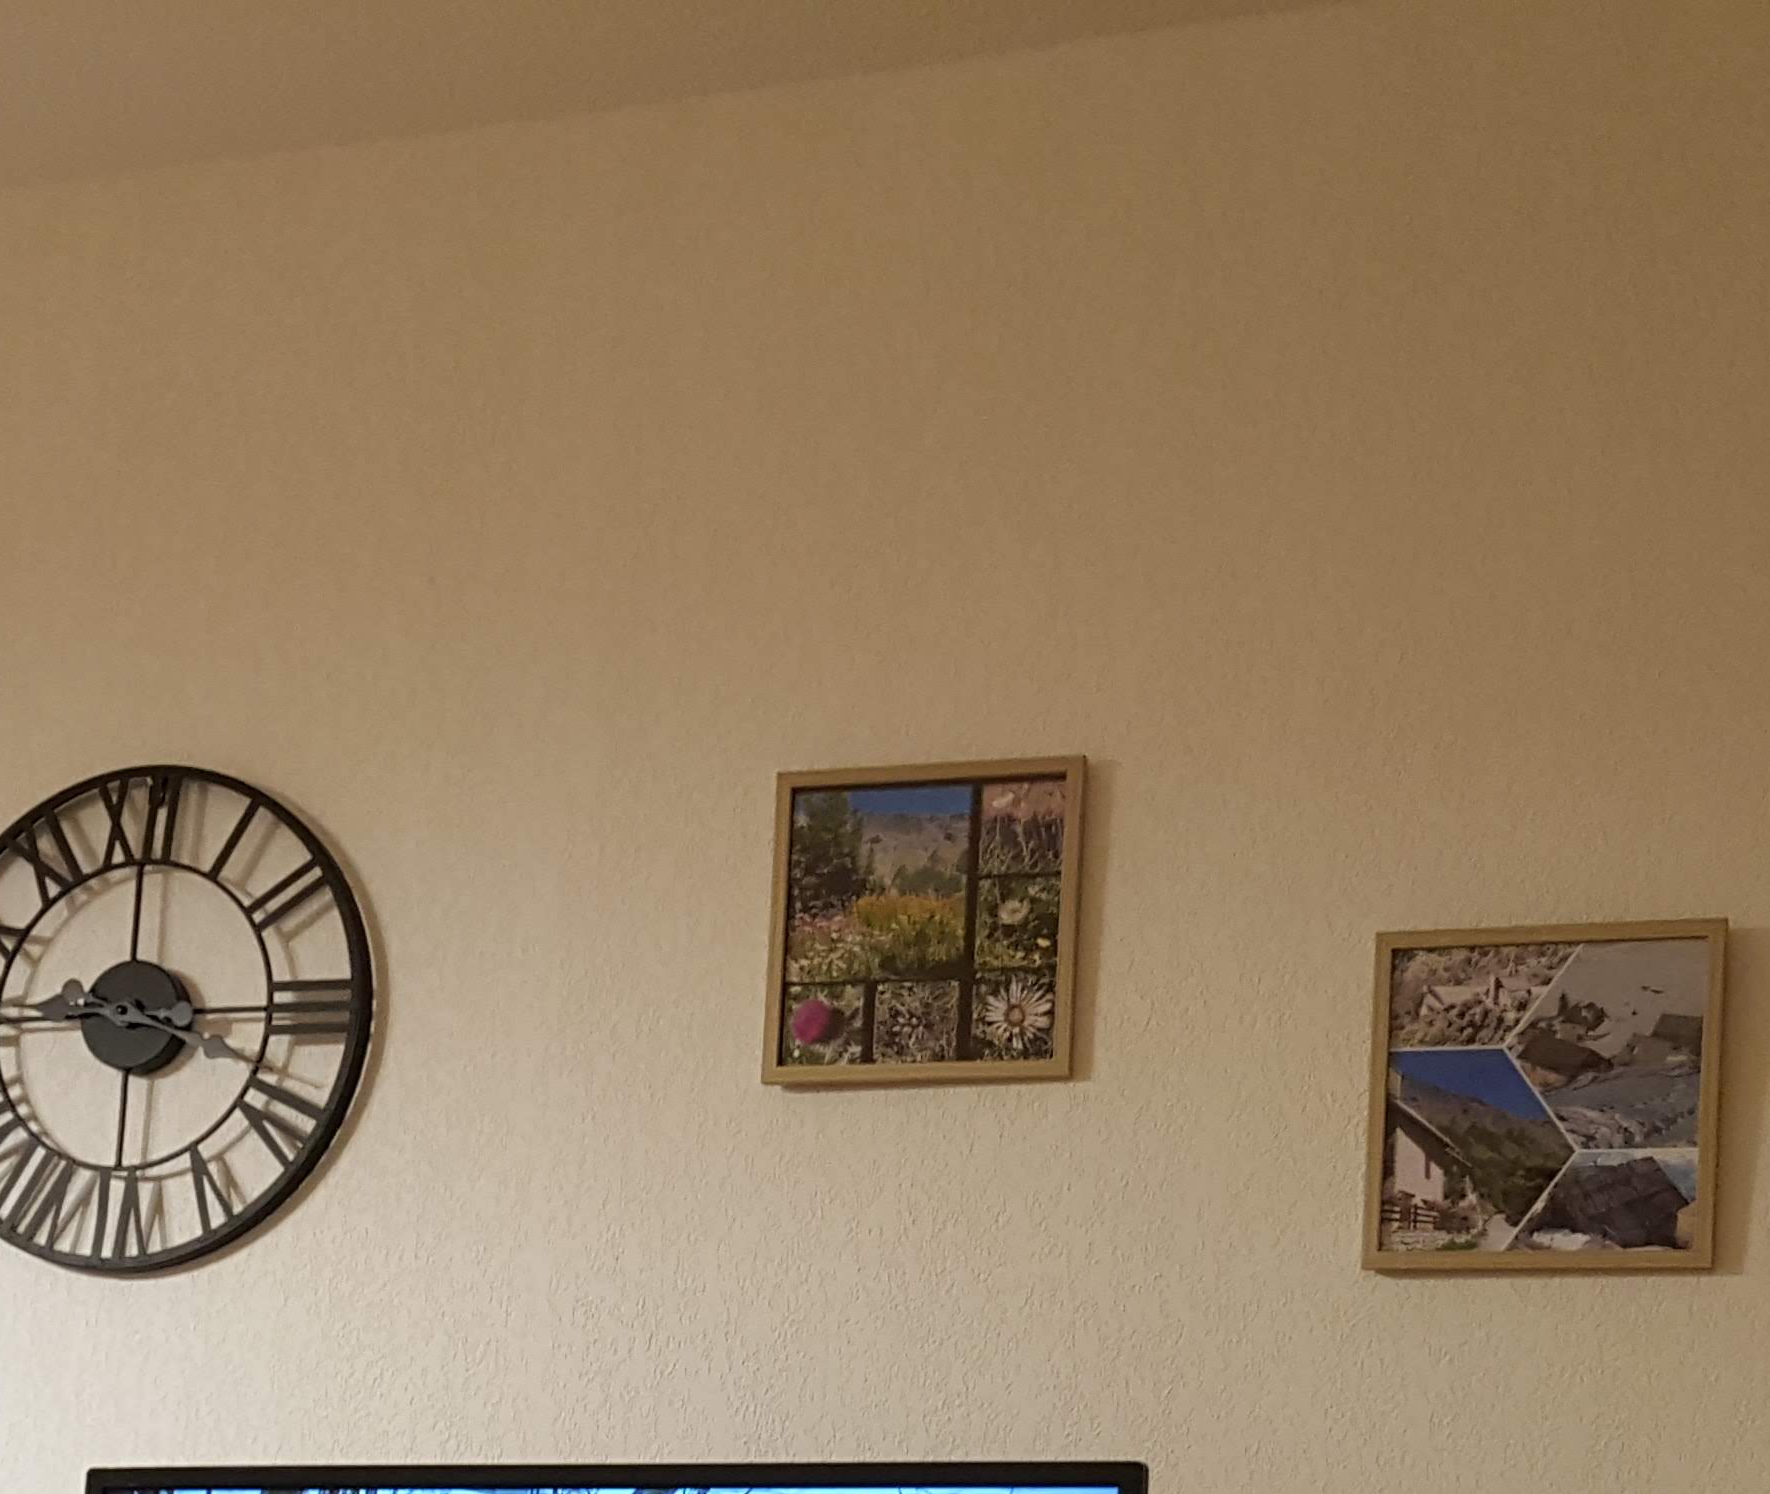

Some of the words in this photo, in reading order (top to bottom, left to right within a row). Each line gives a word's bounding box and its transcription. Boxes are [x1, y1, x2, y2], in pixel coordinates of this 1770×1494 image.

[8, 808, 85, 906] XI
[98, 776, 181, 866] XII
[207, 797, 263, 880] I
[246, 855, 329, 932] II
[270, 979, 352, 1034] III
[189, 1143, 234, 1235] V
